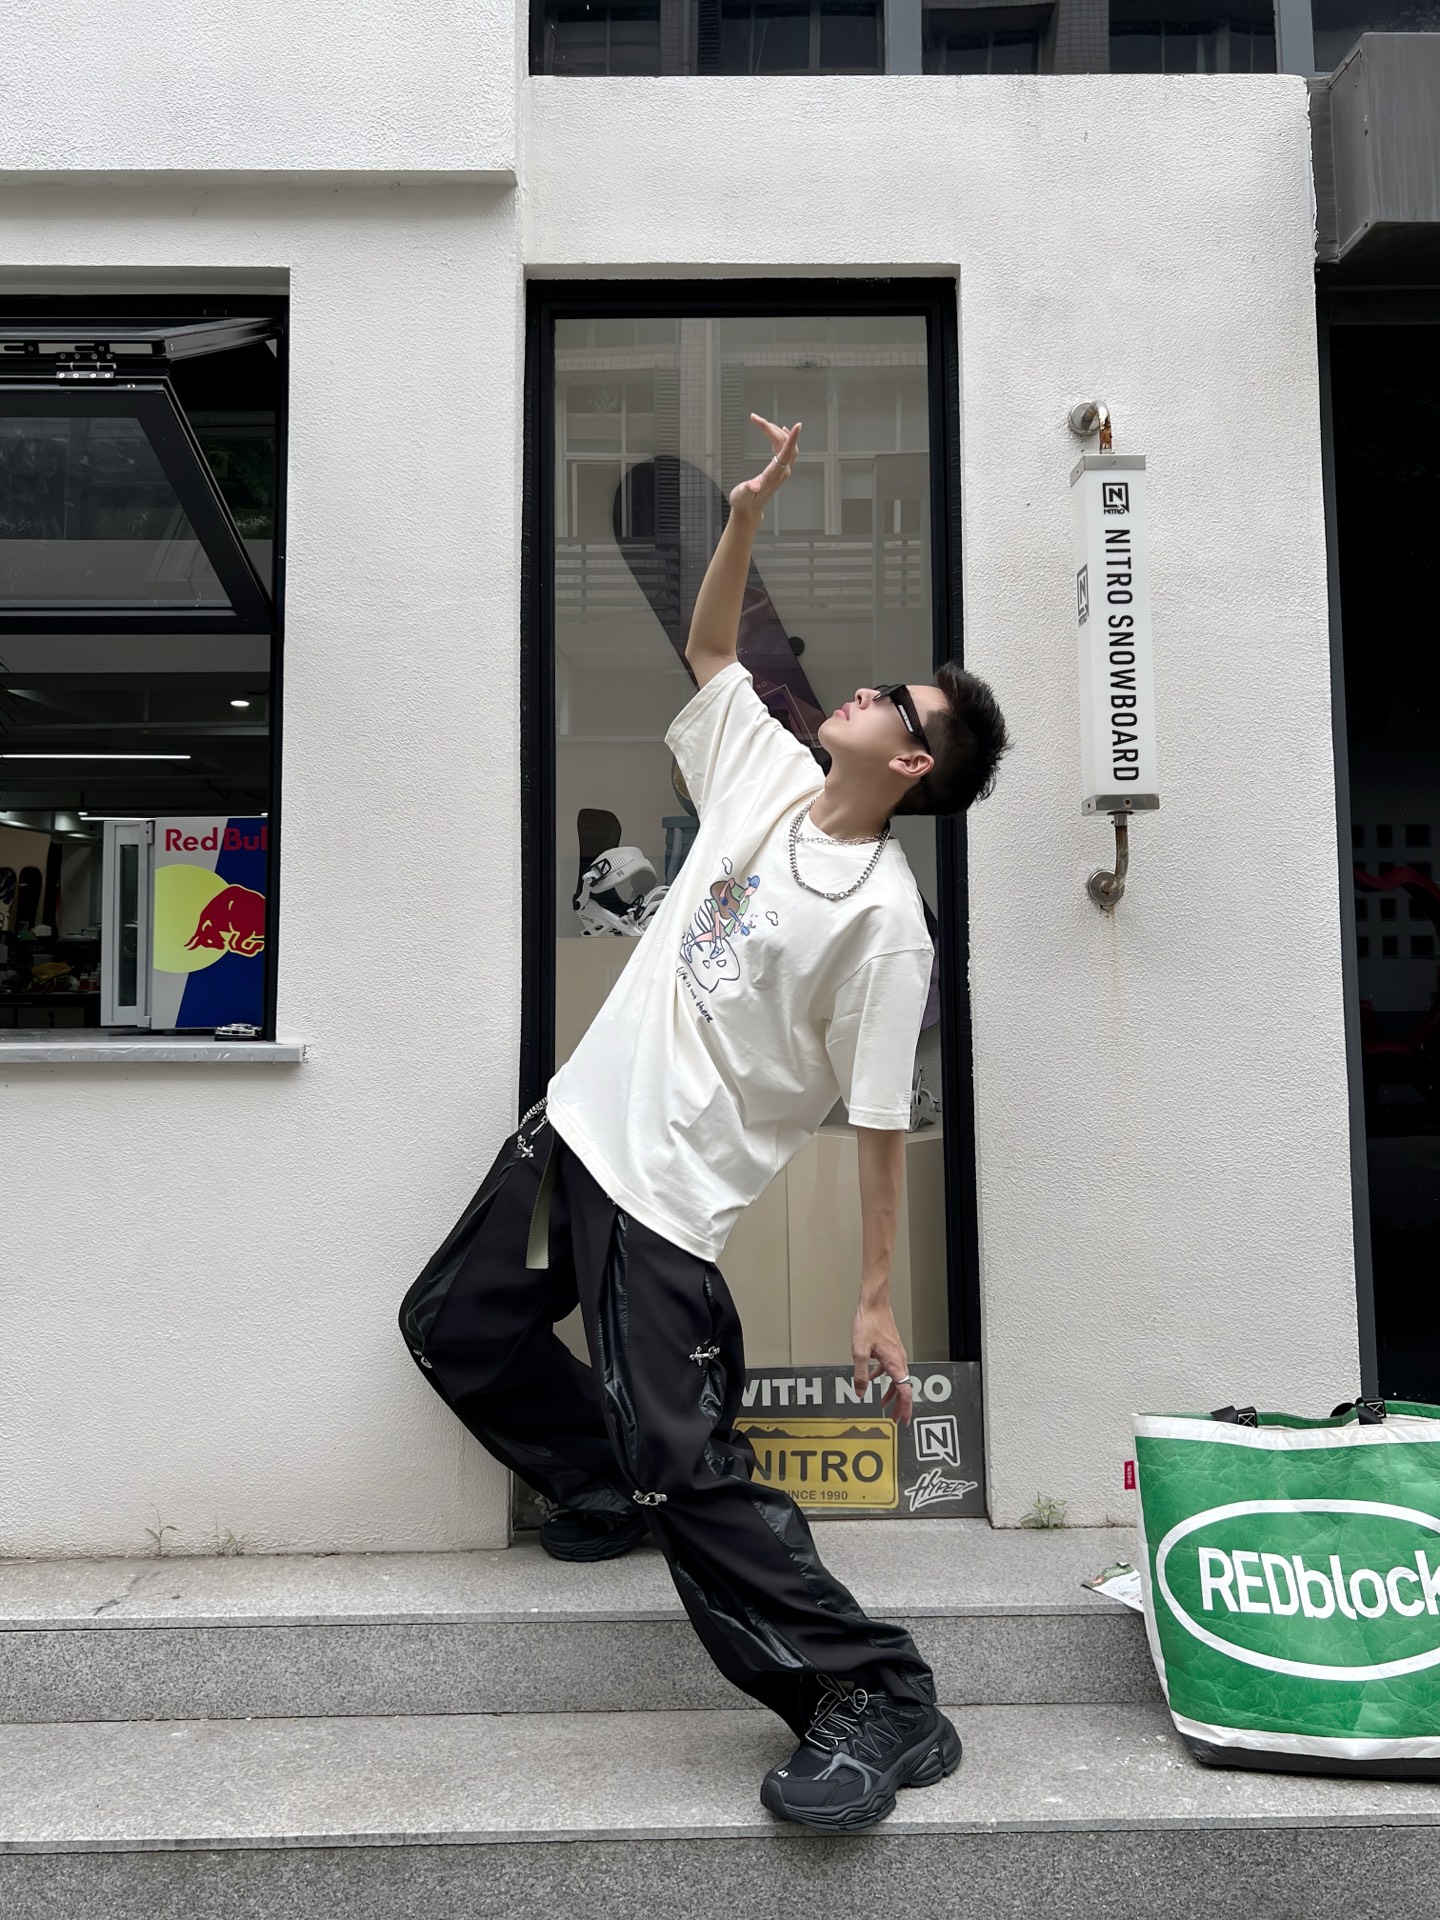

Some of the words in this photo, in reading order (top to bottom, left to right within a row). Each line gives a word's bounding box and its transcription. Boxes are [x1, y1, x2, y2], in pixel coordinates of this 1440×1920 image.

[1105, 529, 1133, 605] NITRO
[1108, 615, 1139, 781] SNOWBOARD
[165, 827, 218, 851] Red
[223, 826, 268, 851] Bul
[696, 1001, 713, 1023] there
[754, 1450, 883, 1482] NITRO
[787, 1489, 816, 1500] NCE
[820, 1490, 848, 1500] 1990
[1197, 1546, 1440, 1620] REDblock
